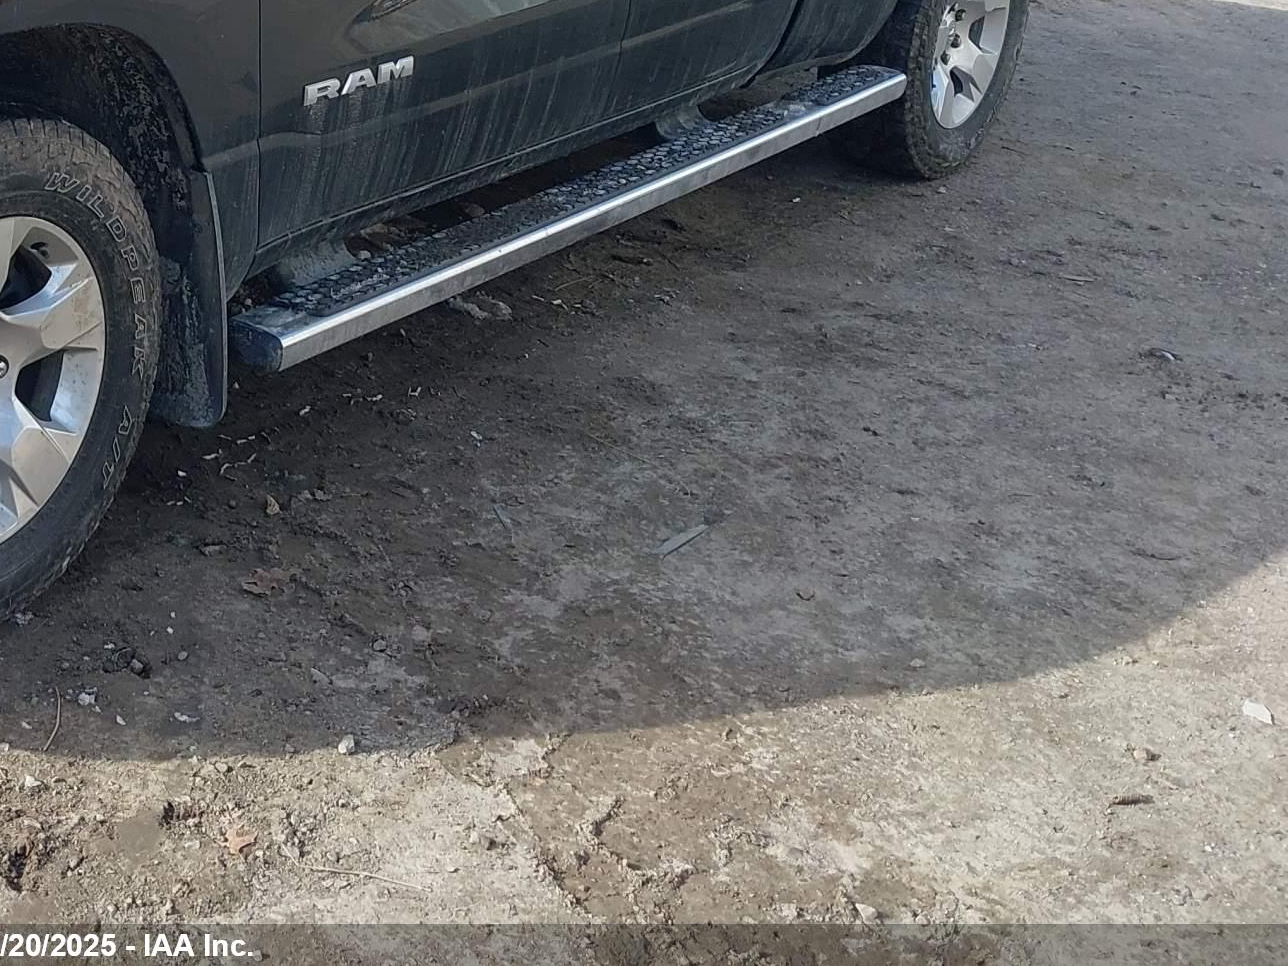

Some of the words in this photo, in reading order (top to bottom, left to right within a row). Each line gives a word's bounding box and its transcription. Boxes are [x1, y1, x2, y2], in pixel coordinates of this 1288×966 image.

[303, 55, 414, 106] RAM
[43, 171, 147, 380] WILDPEAK
[102, 404, 133, 491] A/T
